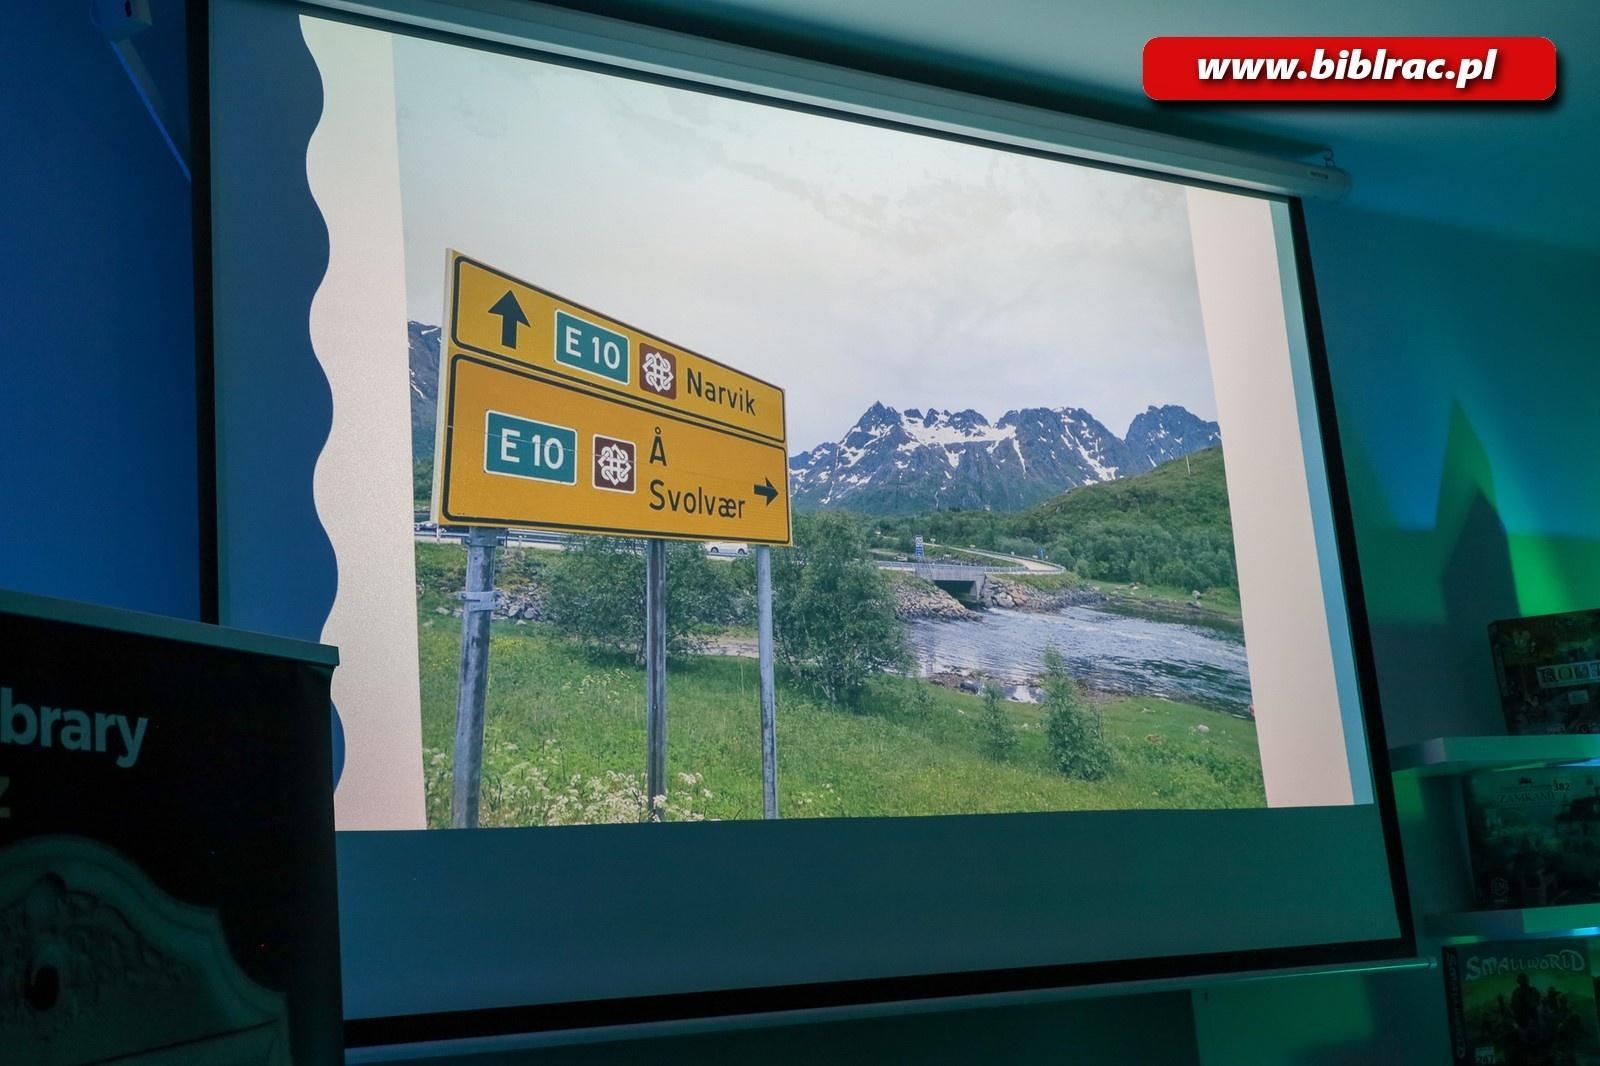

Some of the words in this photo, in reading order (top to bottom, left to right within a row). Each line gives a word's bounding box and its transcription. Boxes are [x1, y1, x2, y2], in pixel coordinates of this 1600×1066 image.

[565, 325, 583, 358] E
[592, 336, 621, 370] 10
[686, 367, 757, 416] Narvik
[499, 427, 521, 464] E
[531, 435, 565, 470] 10
[649, 426, 668, 467] Å
[649, 479, 746, 519] Svolvær
